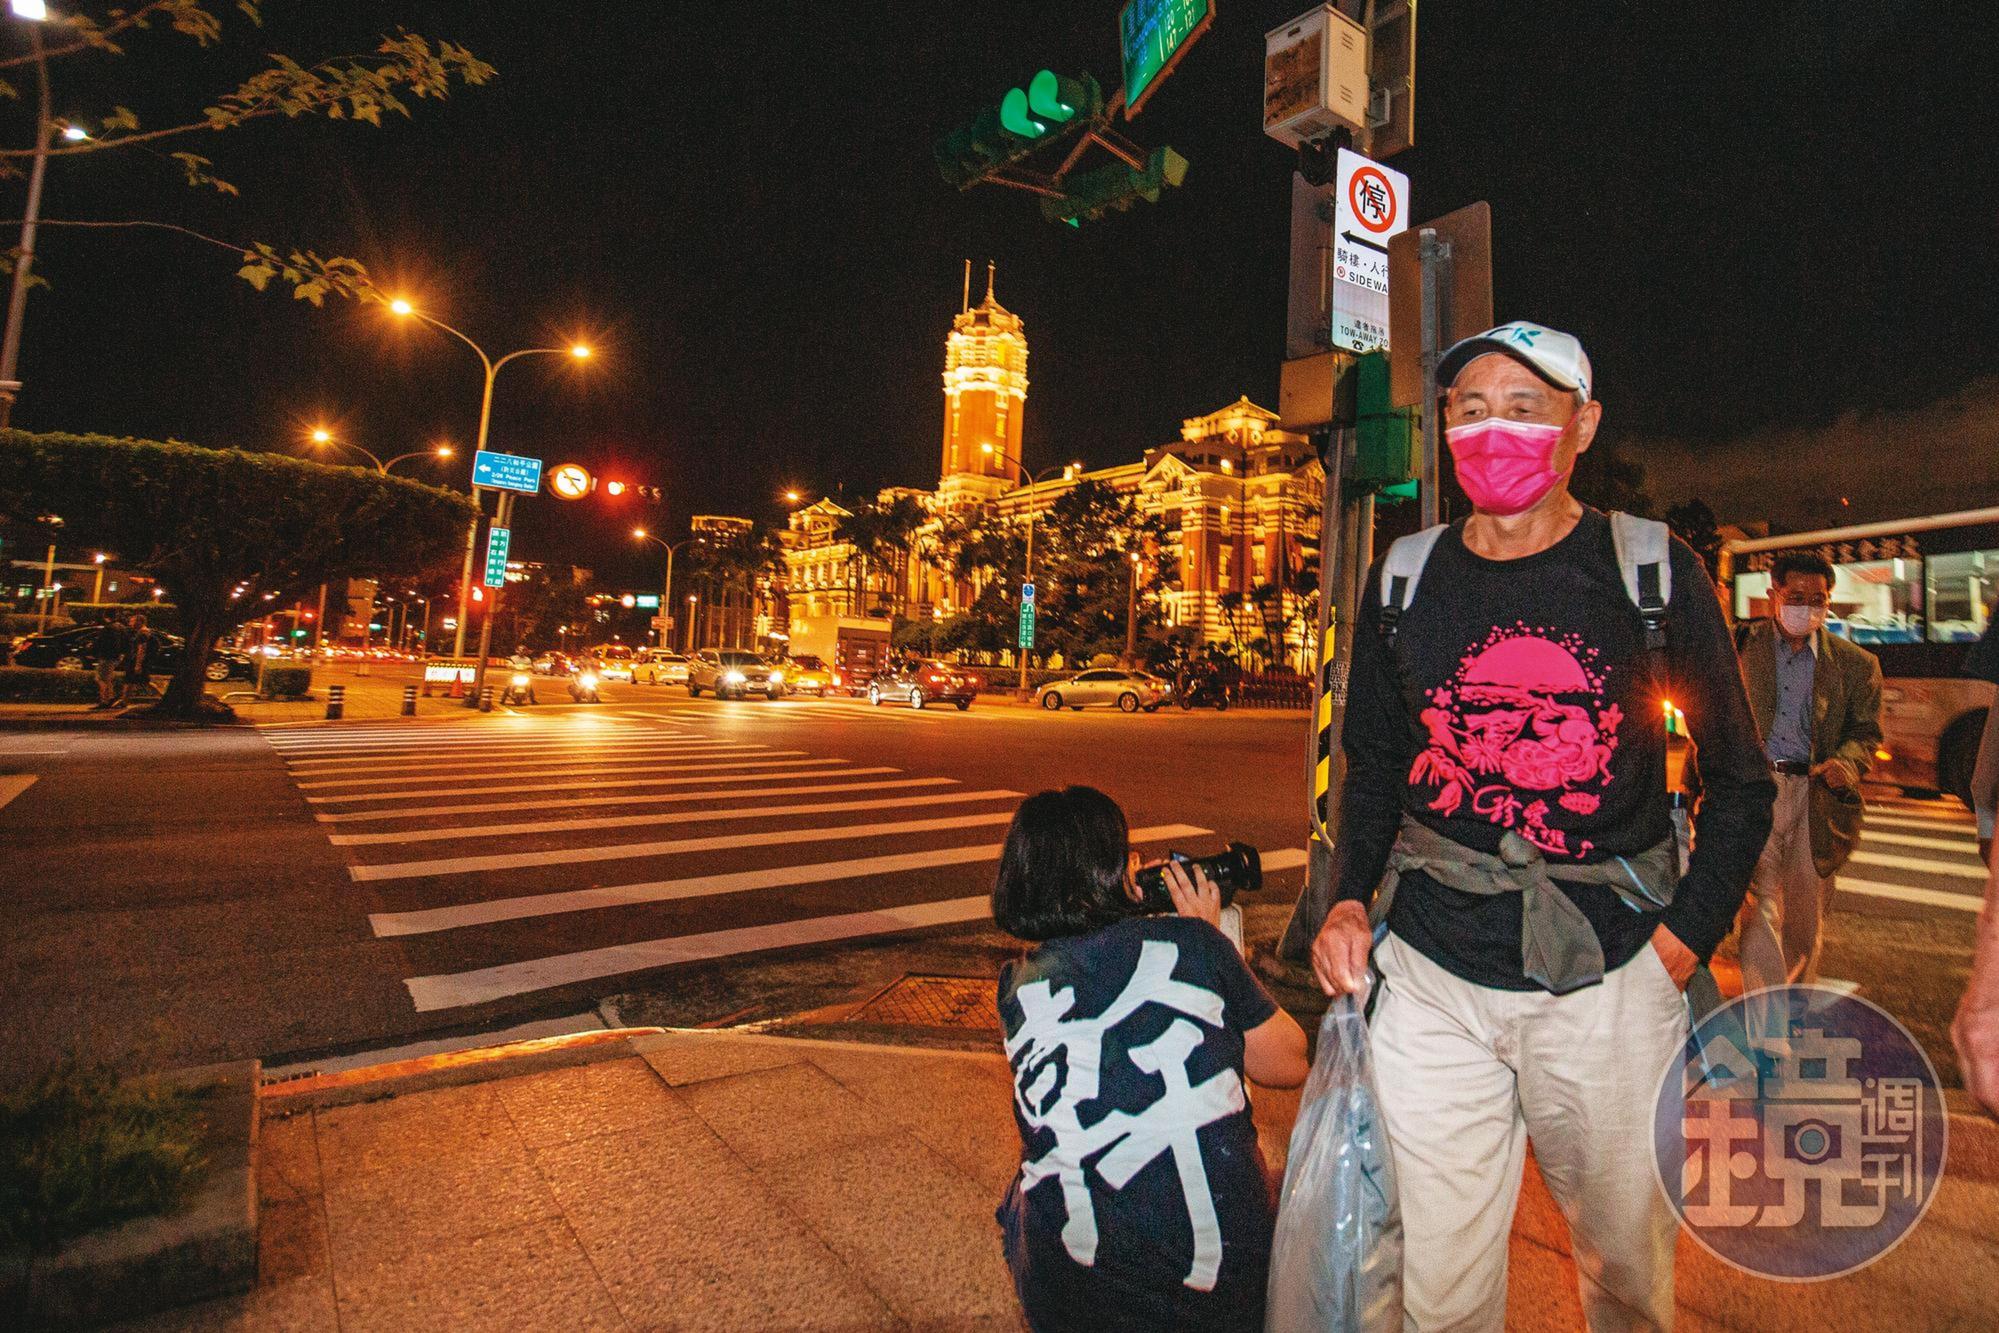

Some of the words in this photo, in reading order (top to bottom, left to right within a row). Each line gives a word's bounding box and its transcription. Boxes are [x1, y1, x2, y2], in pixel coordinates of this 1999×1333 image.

[1359, 179, 1386, 219] 停
[1349, 271, 1388, 294] SIDEWA
[1340, 325, 1378, 344] TOW-AWAY
[493, 456, 539, 470] 二二八和平公園
